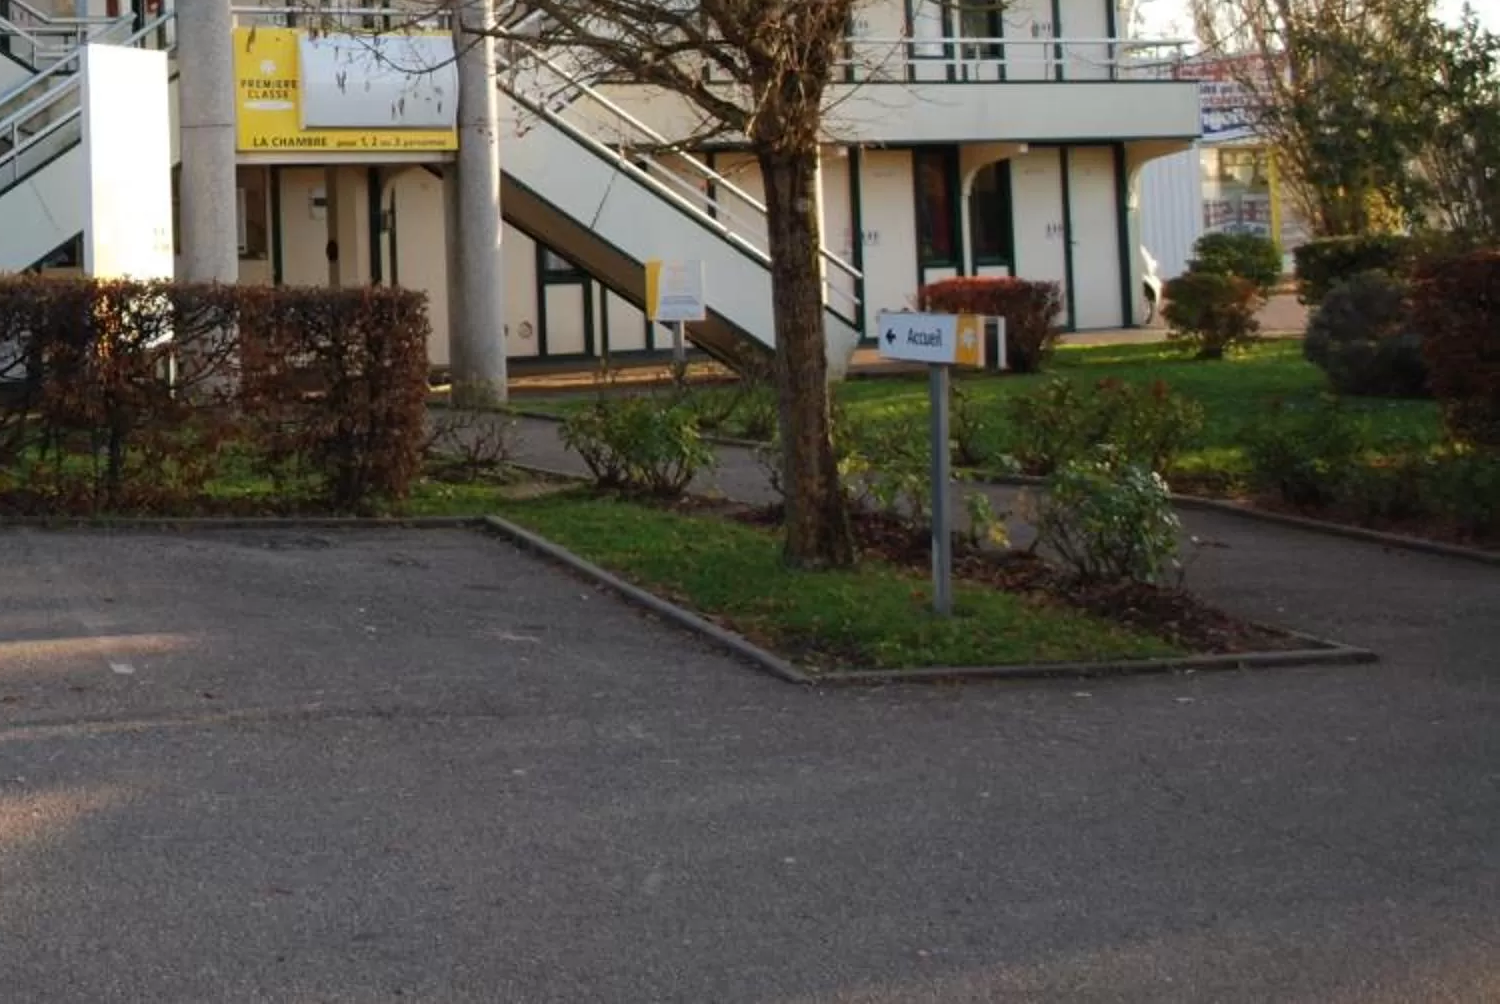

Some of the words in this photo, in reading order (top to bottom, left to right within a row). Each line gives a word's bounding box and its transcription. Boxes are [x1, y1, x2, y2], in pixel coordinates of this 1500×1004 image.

[247, 89, 289, 99] CLASSE
[252, 136, 268, 147] LA
[271, 136, 328, 147] CHAMBRE
[906, 327, 942, 347] Accueil
